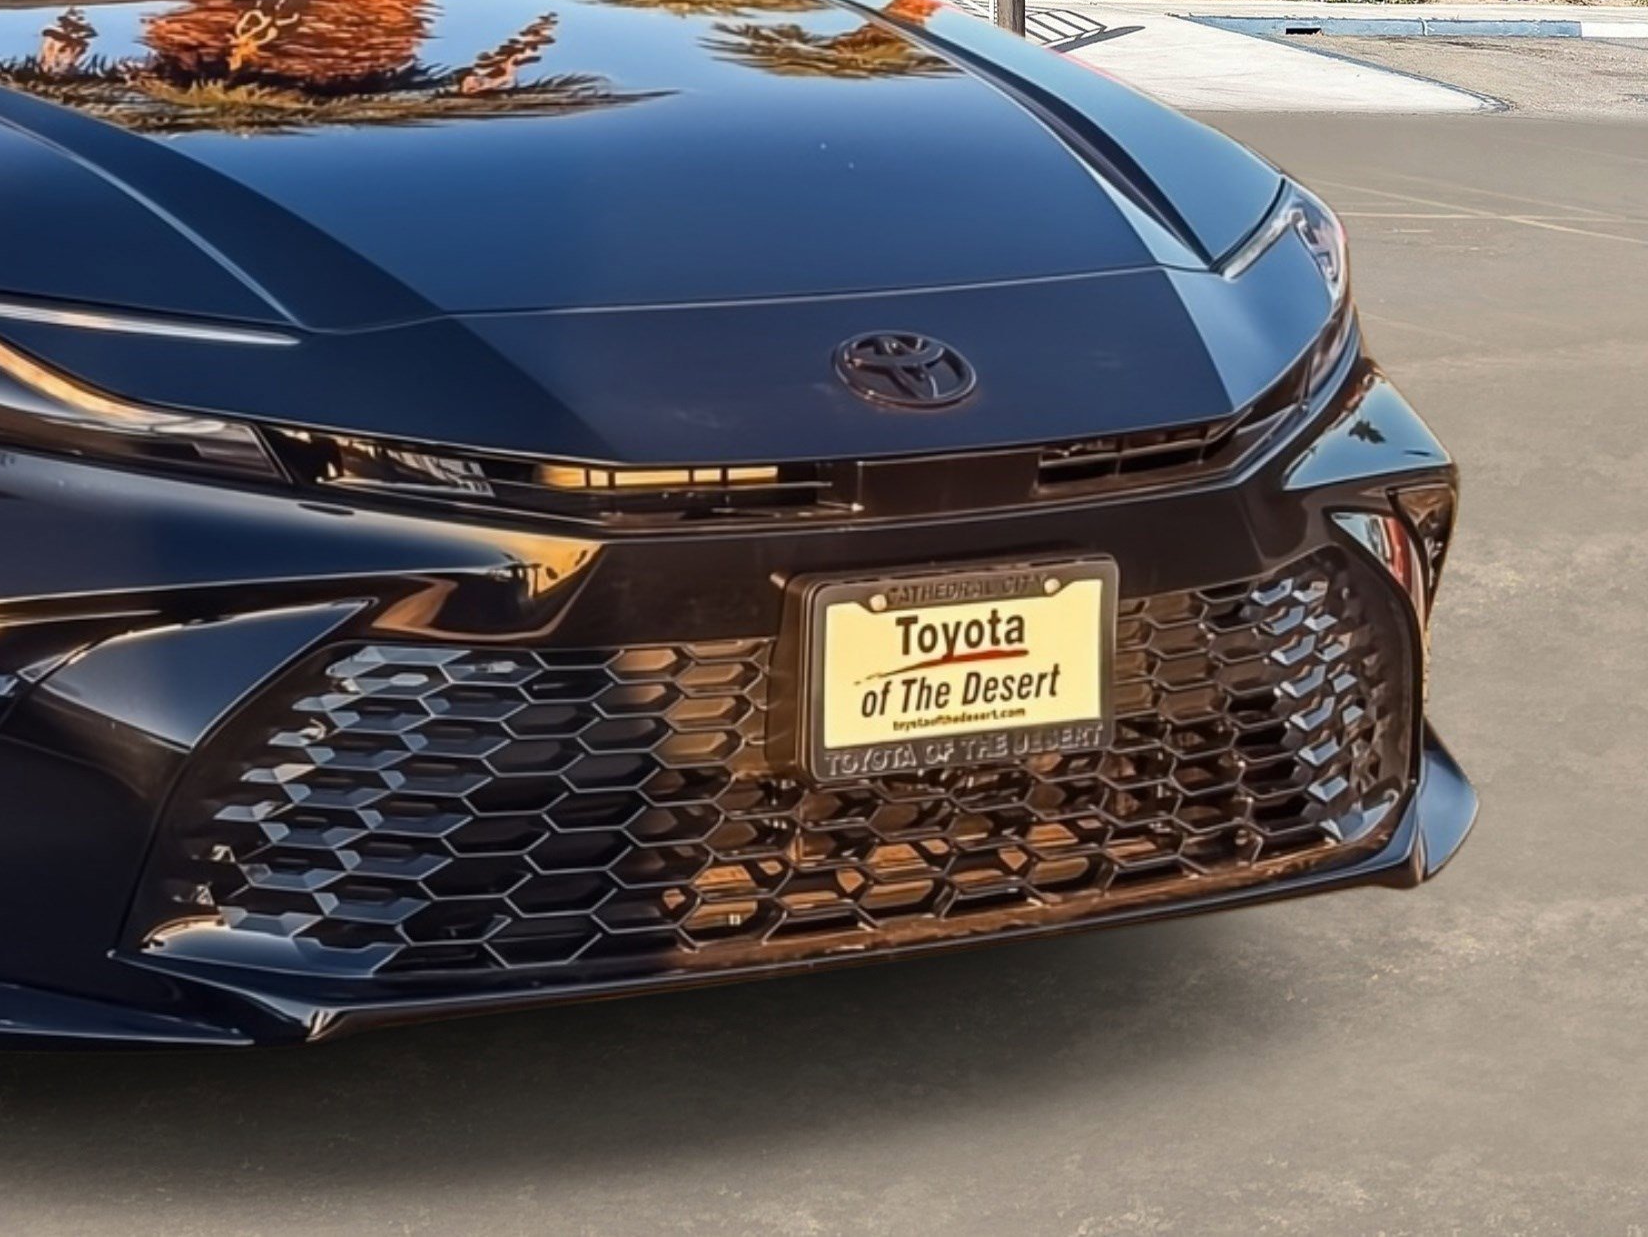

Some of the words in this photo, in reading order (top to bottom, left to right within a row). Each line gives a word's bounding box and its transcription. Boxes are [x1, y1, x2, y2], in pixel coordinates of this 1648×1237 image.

[888, 577, 992, 605] CATHEDRAL
[1002, 572, 1048, 594] CITY
[895, 608, 1026, 660] Toyota
[861, 680, 892, 718] of
[901, 677, 951, 713] The
[962, 663, 1061, 705] Desert
[824, 743, 917, 776] TOYOTA
[924, 742, 954, 765] OF
